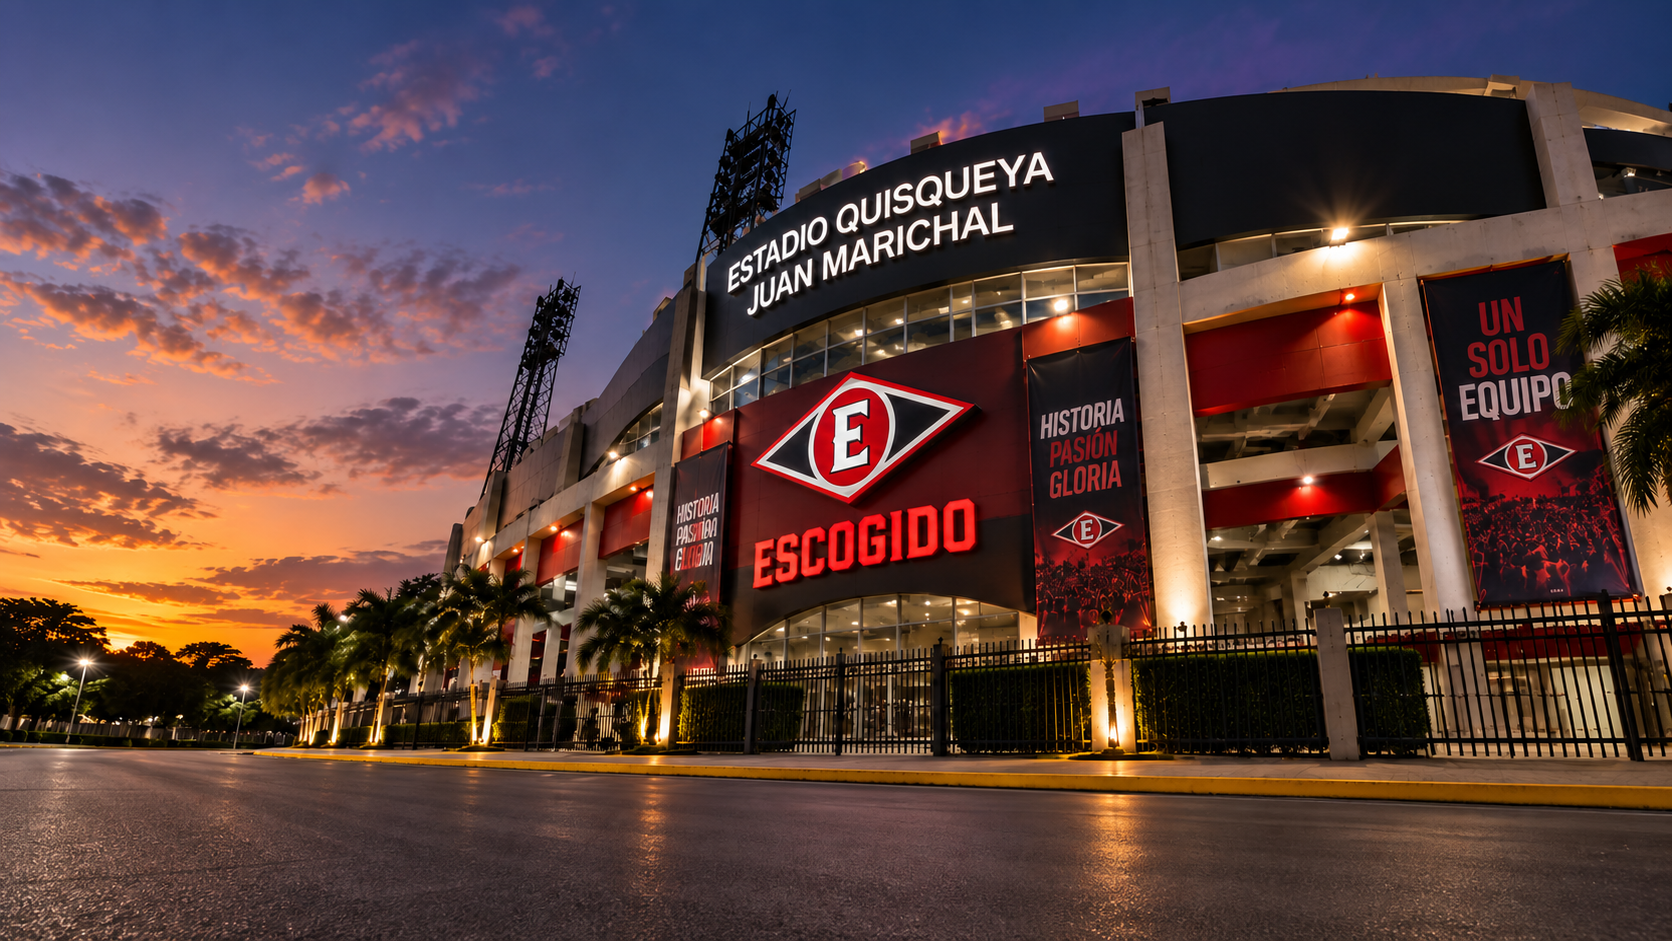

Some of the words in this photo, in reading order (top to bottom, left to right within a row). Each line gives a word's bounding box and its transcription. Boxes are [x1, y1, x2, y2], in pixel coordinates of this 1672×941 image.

[727, 216, 829, 293] ESTADIO
[835, 151, 1054, 234] QUISQUEYA
[746, 258, 813, 316] JUAN
[822, 202, 1014, 281] MARICHAL
[1478, 296, 1525, 336] UN
[1467, 332, 1550, 378] SOLO
[1458, 371, 1574, 421] EQUIPO
[830, 399, 870, 474] E
[1040, 397, 1125, 440] HISTORIA
[1049, 427, 1118, 468] PASIÓN
[1515, 443, 1537, 469] E
[1049, 459, 1123, 499] GLORIA
[752, 497, 977, 589] ESCOGIDO
[1079, 519, 1094, 541] E
